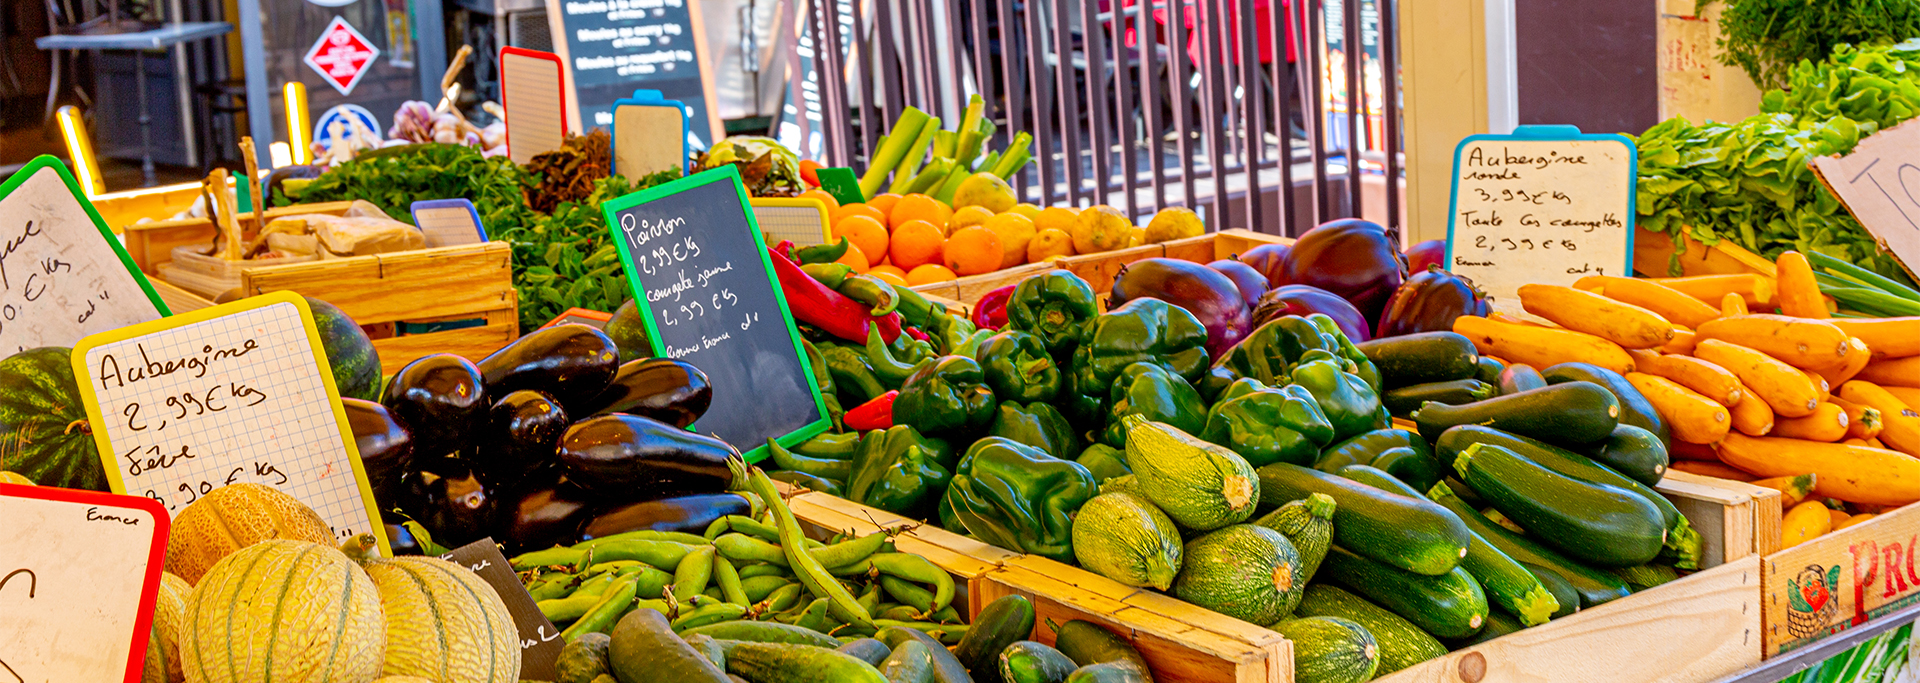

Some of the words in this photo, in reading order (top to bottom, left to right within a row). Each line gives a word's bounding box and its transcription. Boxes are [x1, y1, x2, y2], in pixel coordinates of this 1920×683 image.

[1468, 146, 1588, 170] Aubergine
[621, 213, 686, 249] Poivron
[99, 338, 259, 390] Aubergine
